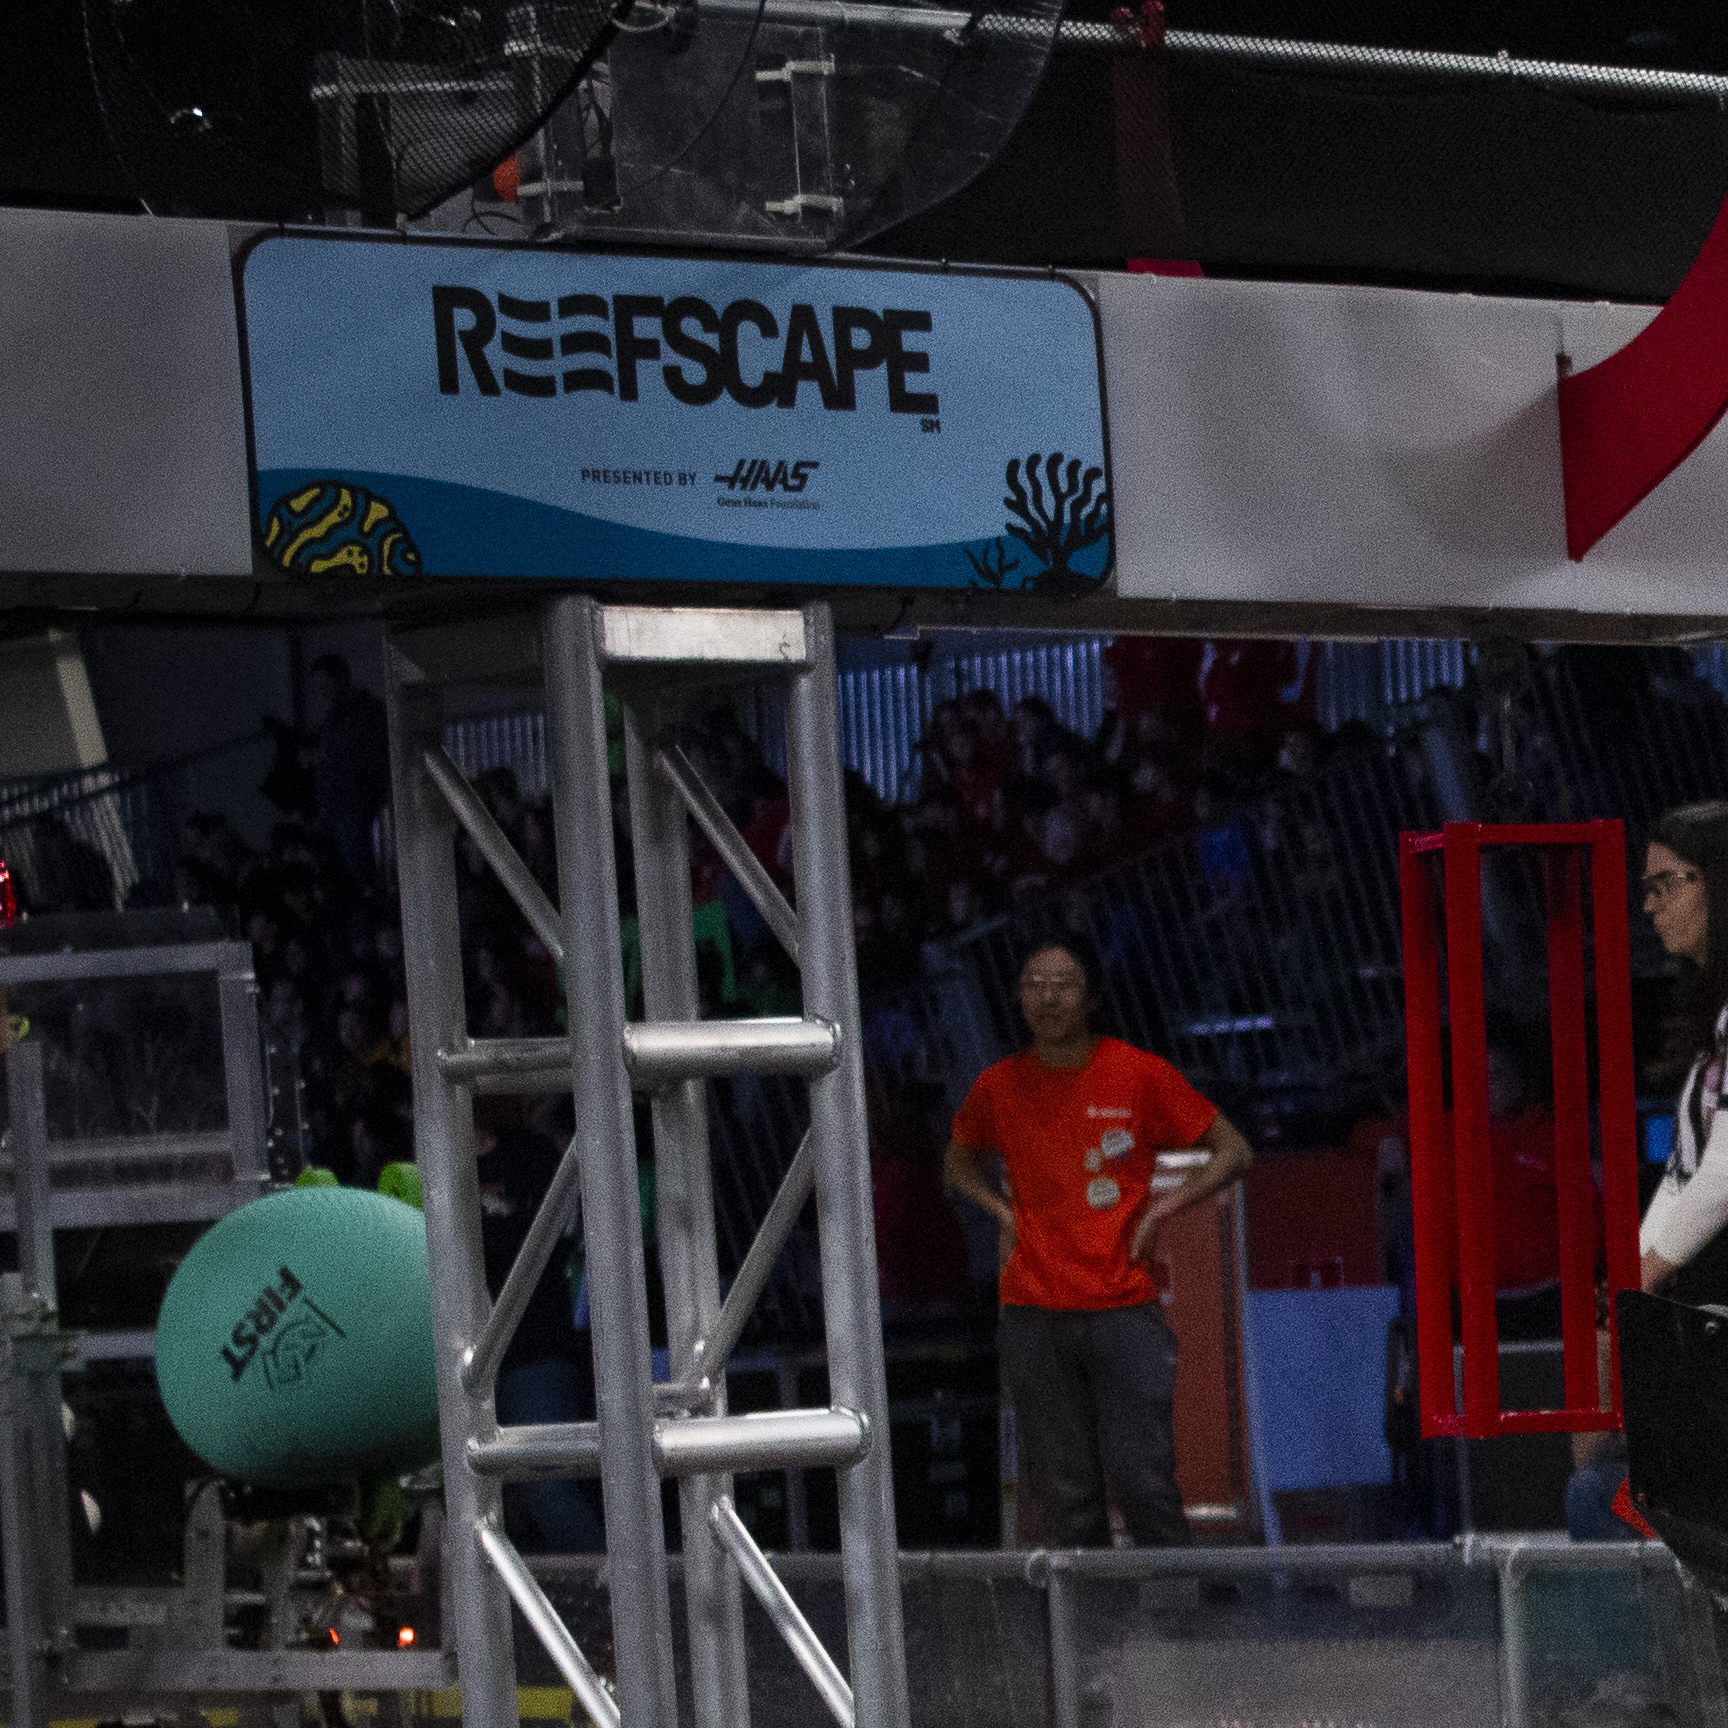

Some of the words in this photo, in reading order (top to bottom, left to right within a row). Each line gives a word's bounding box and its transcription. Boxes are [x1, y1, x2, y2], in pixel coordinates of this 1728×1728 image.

[432, 285, 940, 415] REEFSCAPE
[581, 468, 673, 486] PRESENTED
[678, 471, 697, 487] BY
[714, 458, 820, 492] HAAS
[222, 1266, 302, 1381] FIRST
